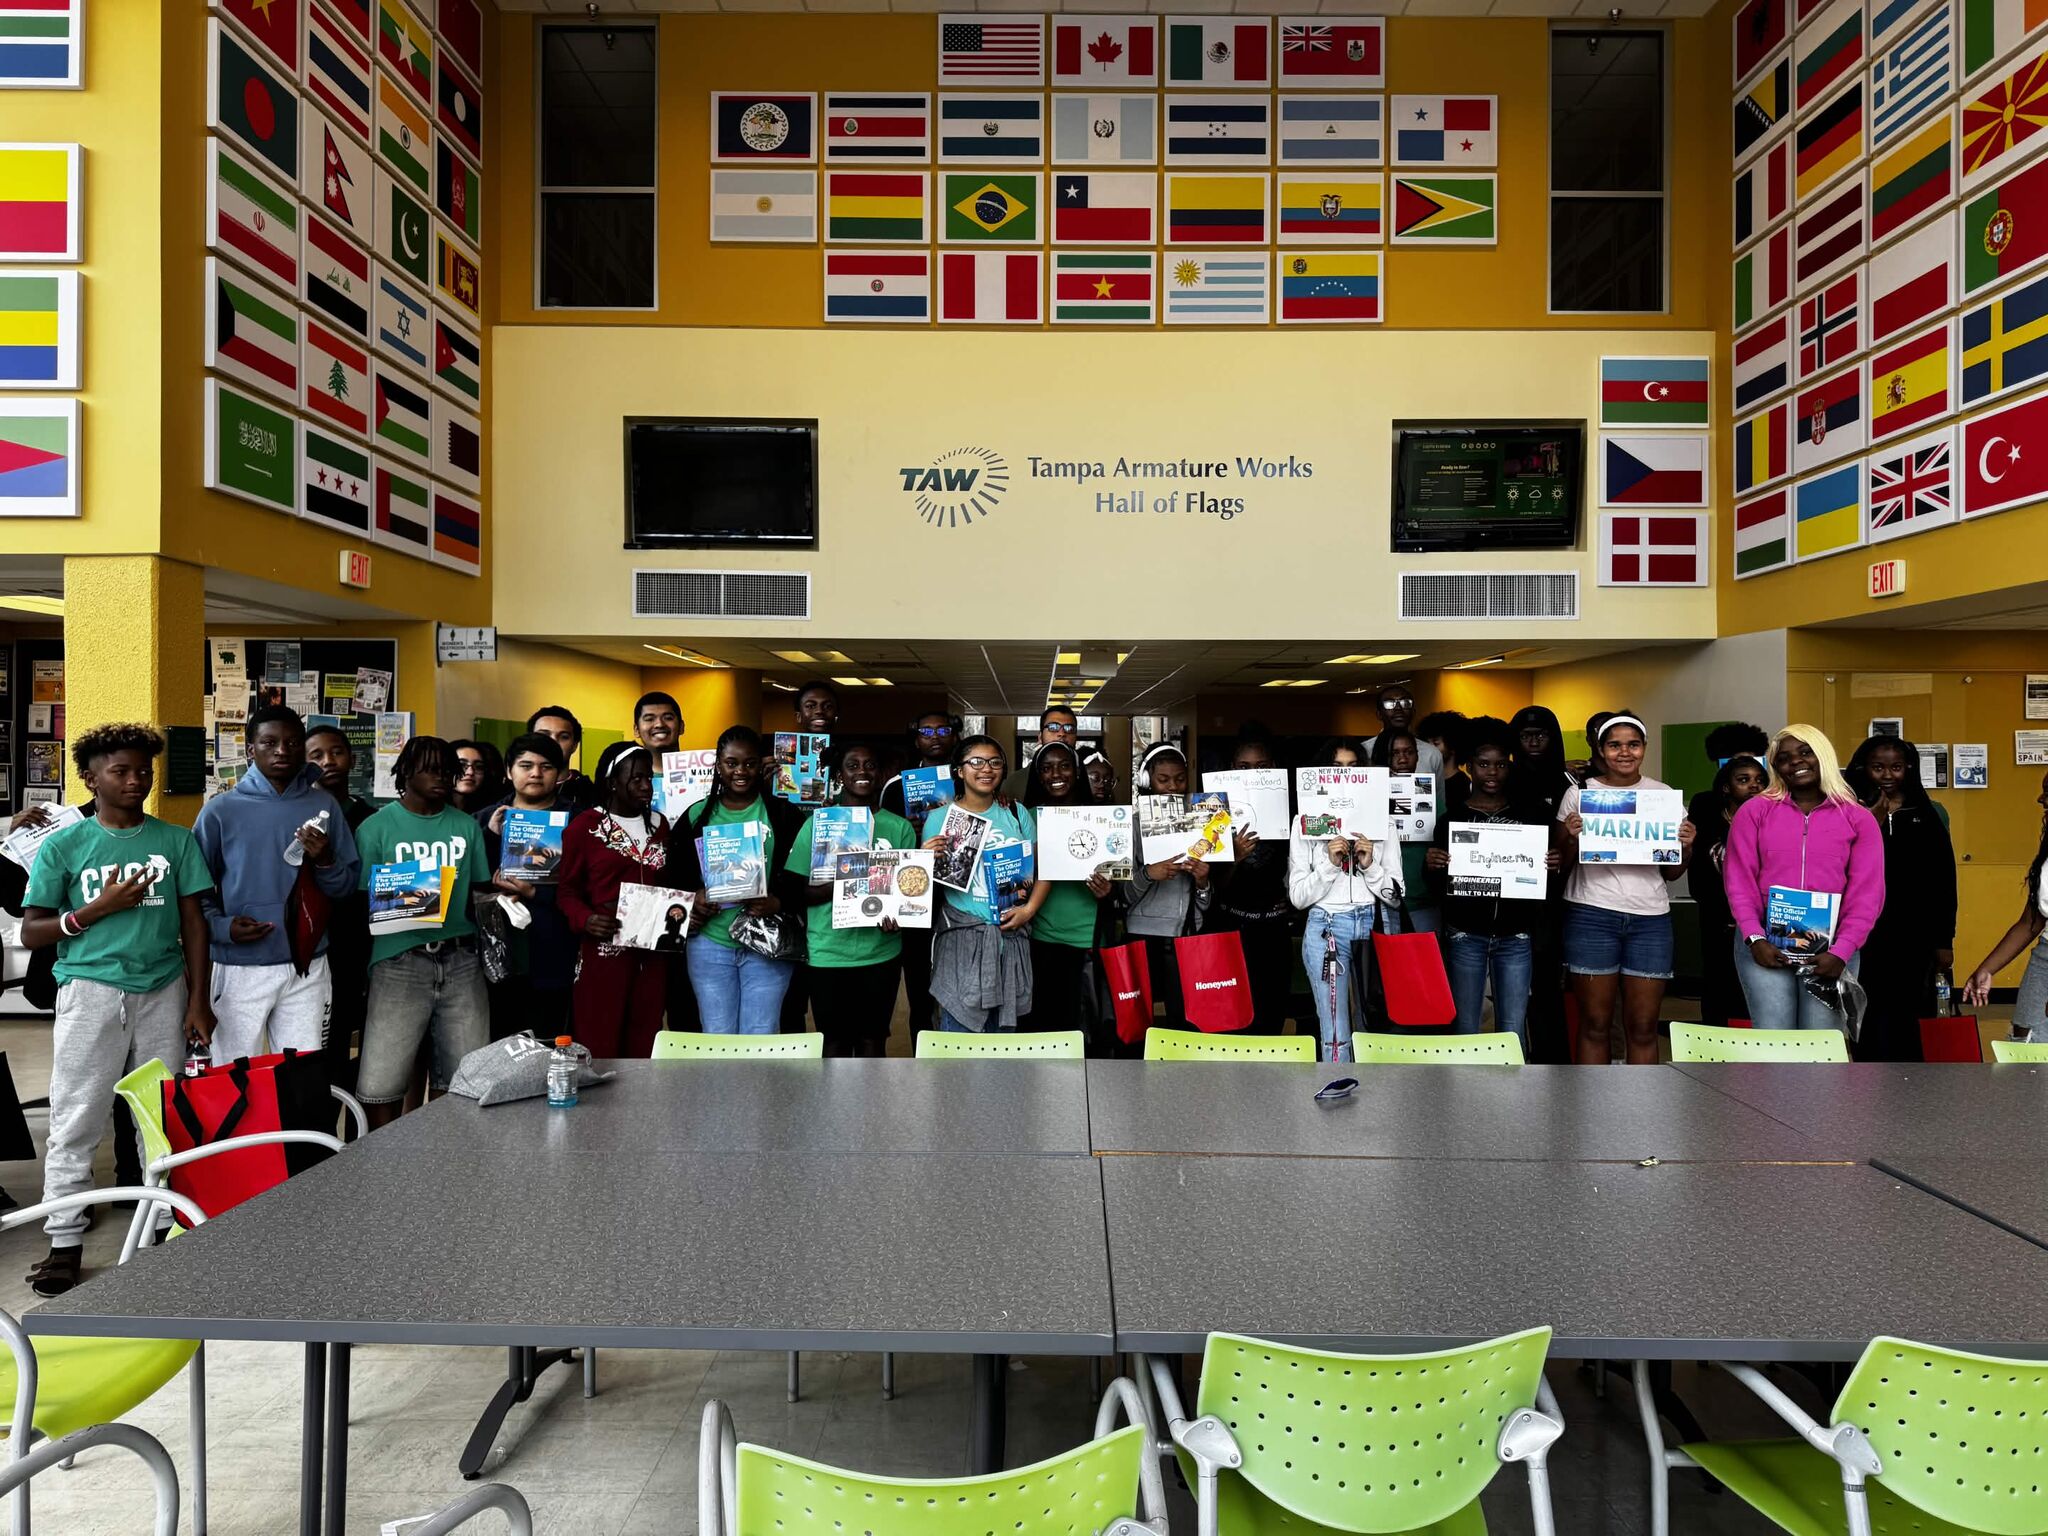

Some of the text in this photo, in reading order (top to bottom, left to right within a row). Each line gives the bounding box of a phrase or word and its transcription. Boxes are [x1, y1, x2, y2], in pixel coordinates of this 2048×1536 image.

[1027, 456, 1313, 484] Tampa Armature Works
[899, 468, 980, 491] TAW
[1095, 491, 1245, 520] Hall of Flags
[351, 554, 369, 586] EXIT
[1872, 562, 1895, 594] EXIT
[2018, 754, 2043, 762] SPAIN
[1319, 774, 1368, 784] NEW YOU!
[1581, 817, 1677, 841] MARINE
[523, 832, 541, 840] Study
[1469, 850, 1534, 869] Engineering
[1005, 862, 1022, 870] Official
[995, 868, 1020, 879] SAT Study
[1453, 876, 1501, 884] ENGINEERED
[1783, 907, 1806, 915] Official
[1769, 918, 1788, 926] Guide
[1784, 913, 1803, 922] Study
[1195, 977, 1237, 991] Honeywell
